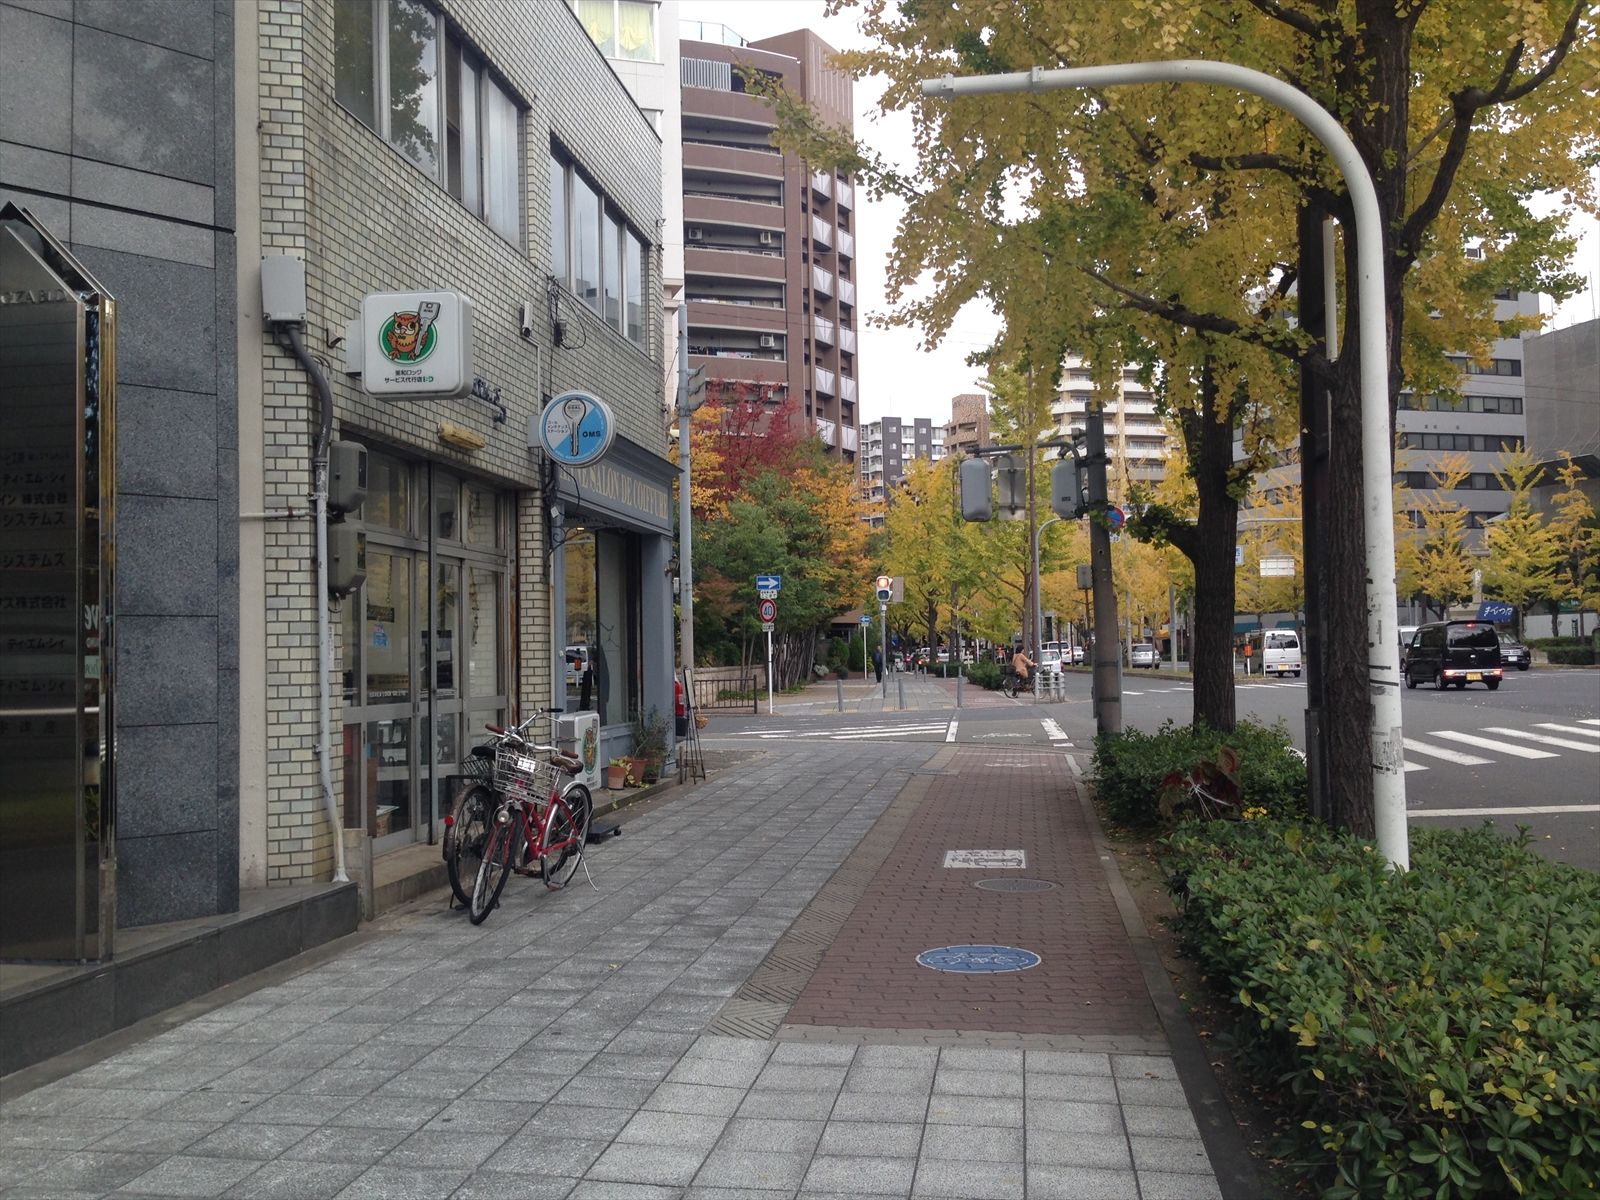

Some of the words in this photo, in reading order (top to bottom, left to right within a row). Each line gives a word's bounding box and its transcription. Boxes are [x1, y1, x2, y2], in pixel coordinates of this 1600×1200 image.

[588, 463, 619, 500] SALON
[620, 474, 633, 506] DE
[633, 479, 669, 520] COIFFURE
[764, 605, 772, 616] 40
